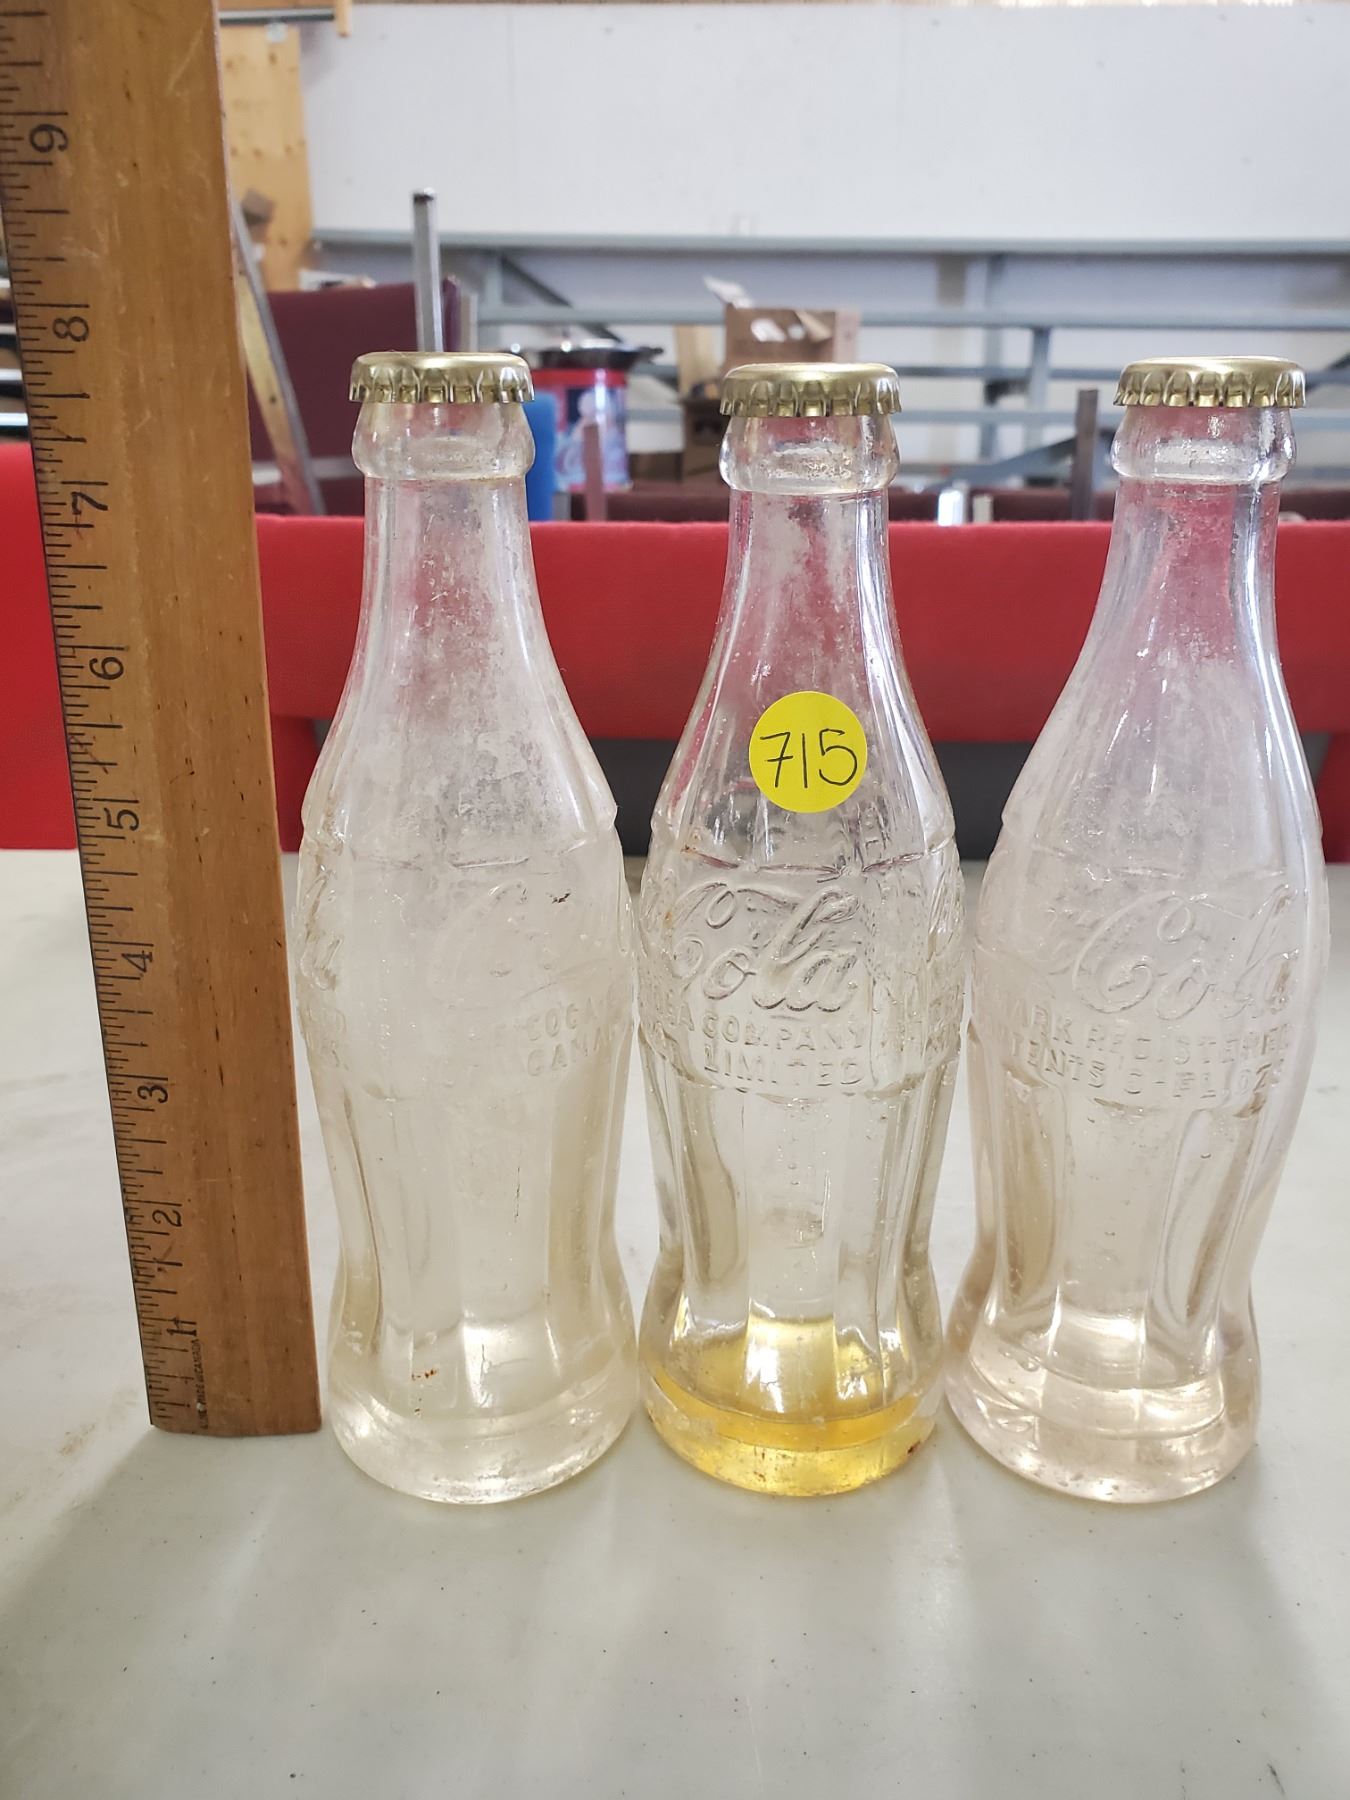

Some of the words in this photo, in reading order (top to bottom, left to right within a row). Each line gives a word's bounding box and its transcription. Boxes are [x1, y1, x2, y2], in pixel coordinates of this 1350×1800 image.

[29, 123, 69, 153] 9
[52, 315, 89, 343] 8
[70, 490, 109, 516] 7
[88, 655, 125, 681] 6
[758, 727, 858, 789] 715
[103, 806, 140, 832] 5
[120, 949, 153, 974] 4
[136, 1084, 169, 1104] 3
[151, 1208, 183, 1228] 2
